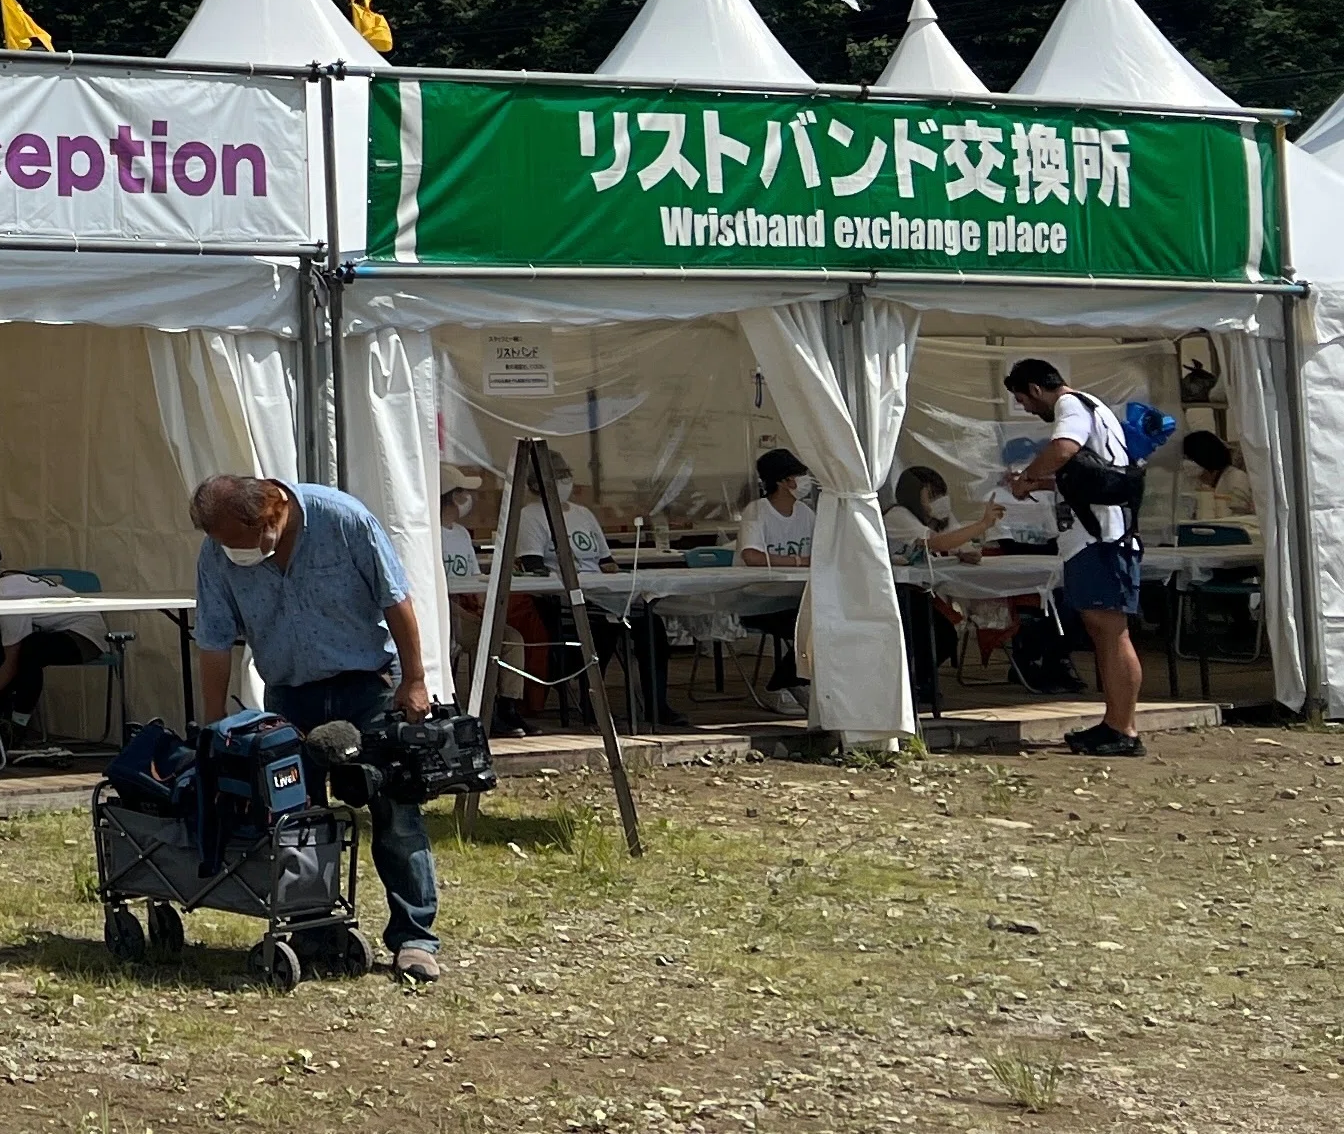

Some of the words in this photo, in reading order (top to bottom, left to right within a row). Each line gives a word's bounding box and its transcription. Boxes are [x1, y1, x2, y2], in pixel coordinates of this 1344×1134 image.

[578, 109, 1131, 209] リストバンド交換所
[659, 205, 826, 249] Wristband
[833, 210, 981, 257] exchange
[987, 214, 1068, 257] place
[496, 346, 539, 359] リストバンド
